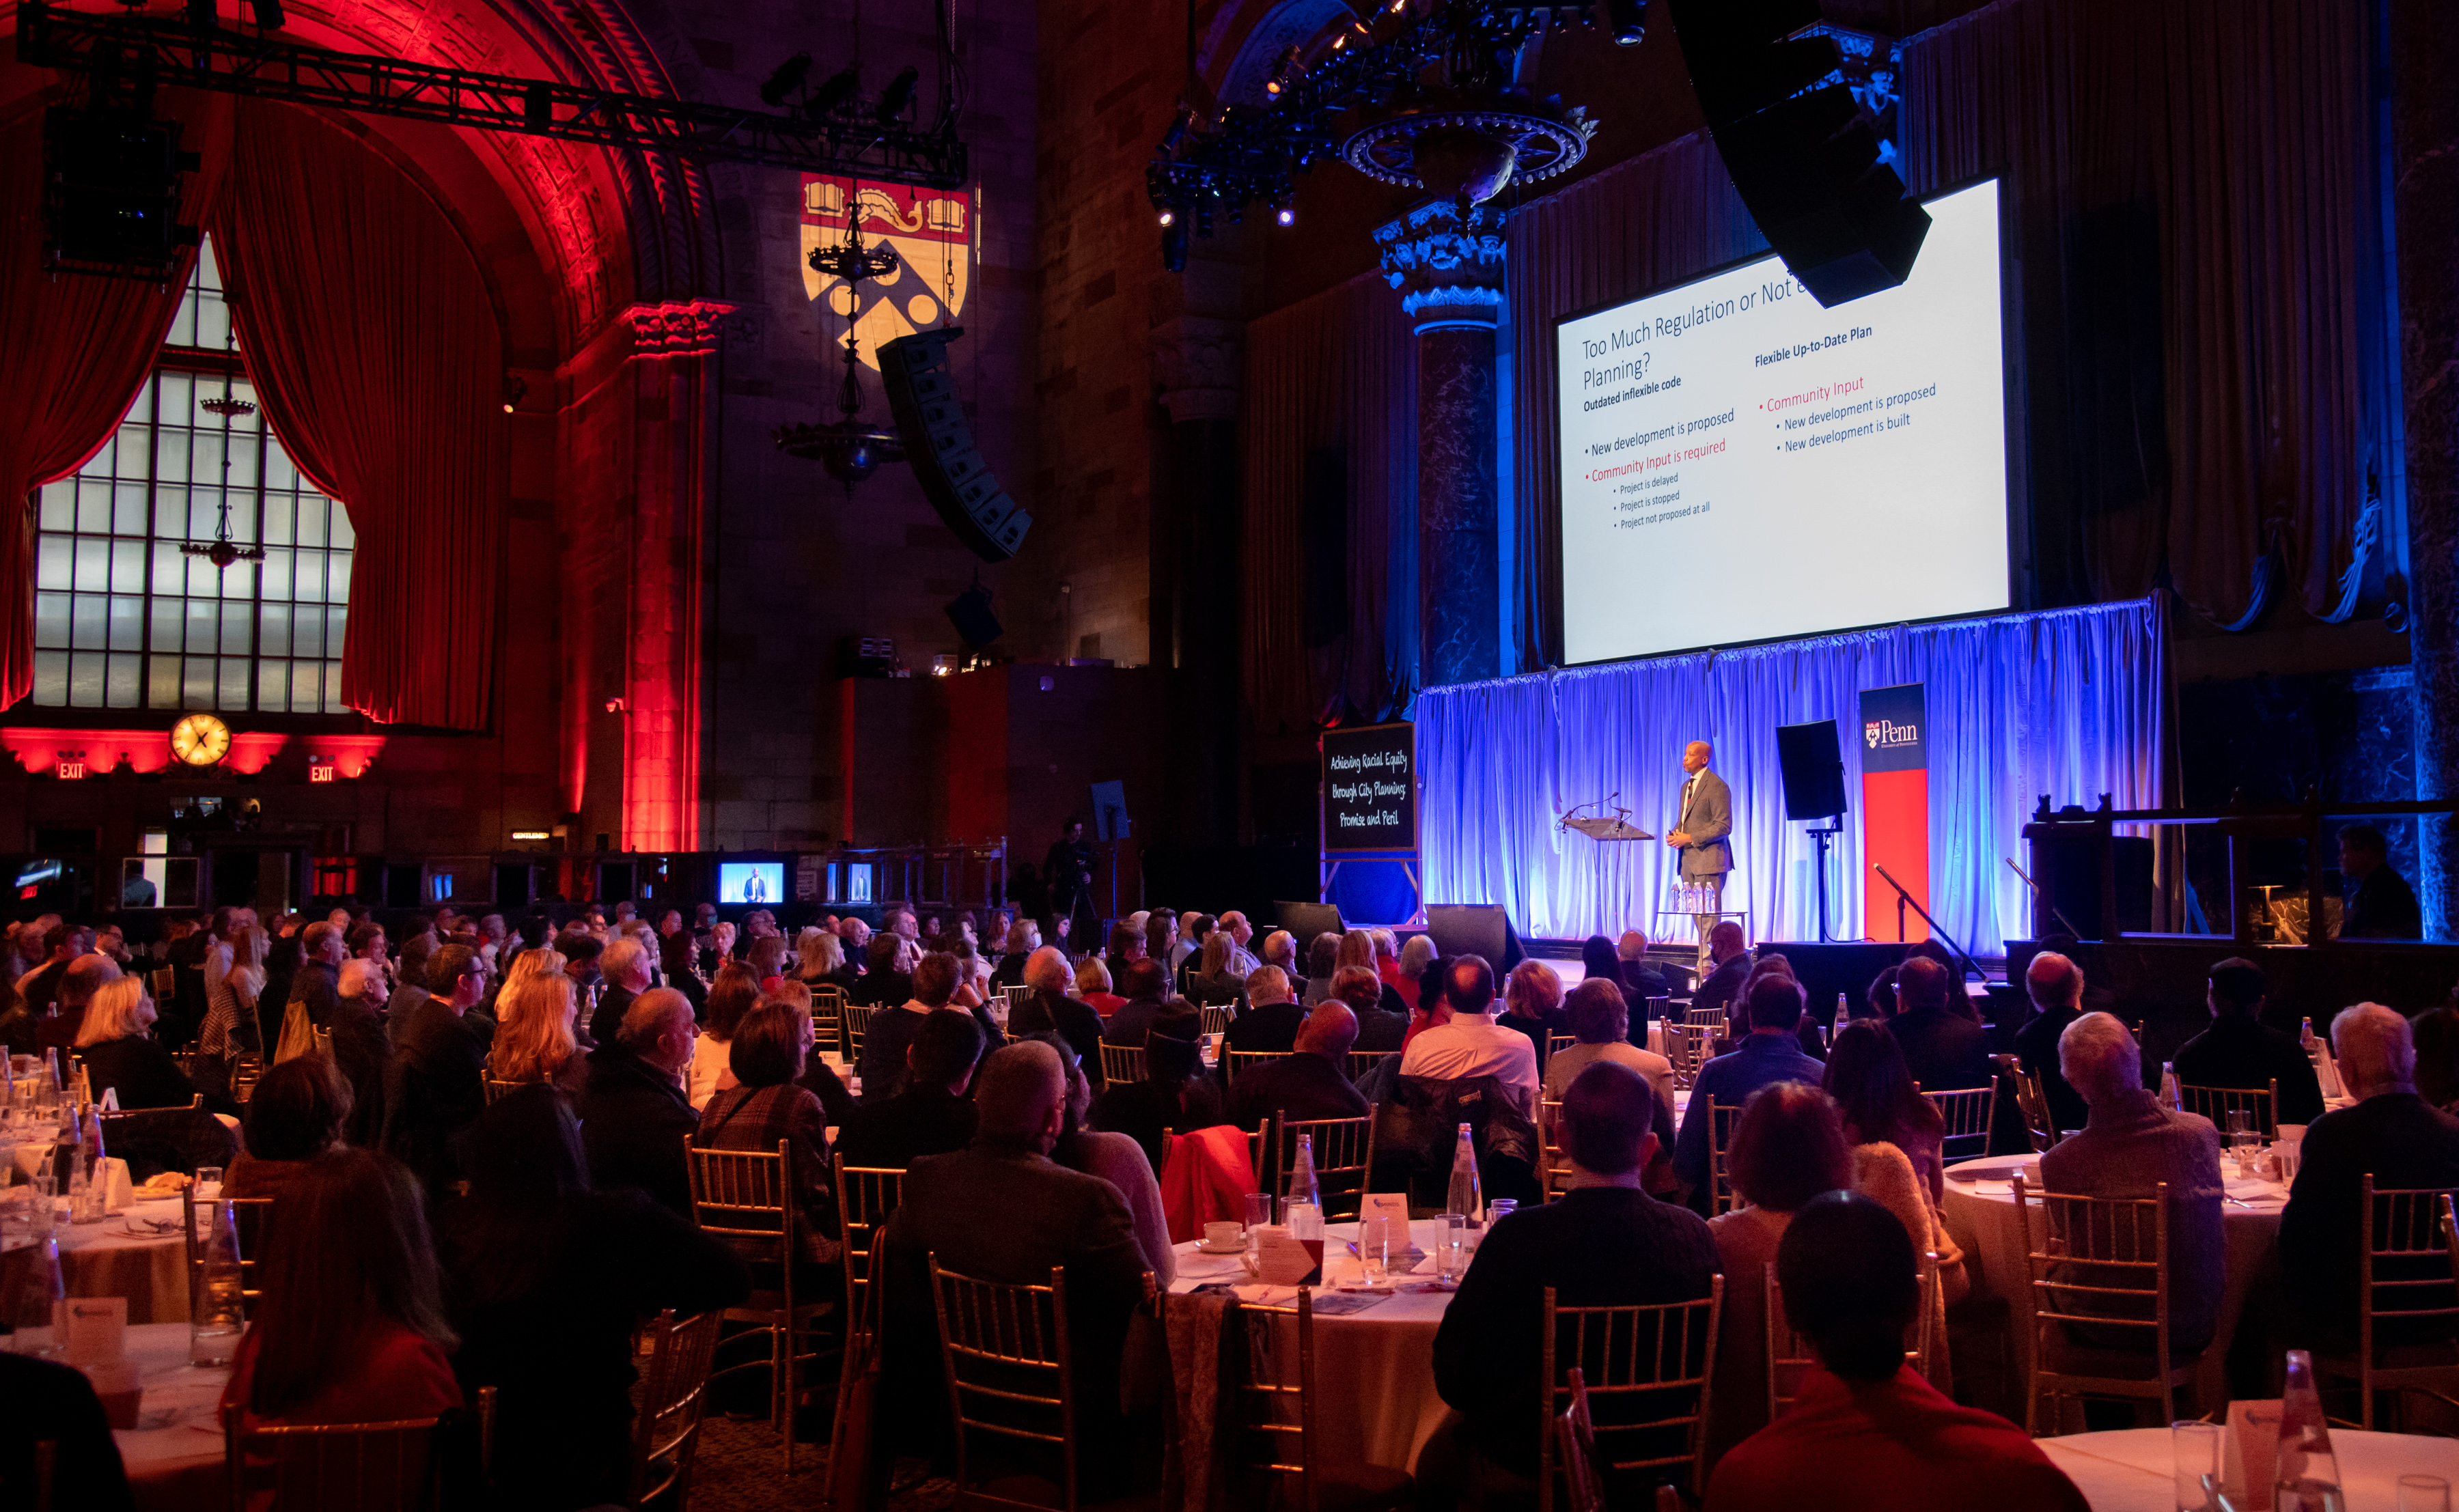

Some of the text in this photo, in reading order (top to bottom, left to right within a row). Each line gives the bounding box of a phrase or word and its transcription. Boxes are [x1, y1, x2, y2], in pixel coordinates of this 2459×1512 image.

[1583, 340, 1607, 359] Too
[1611, 322, 1650, 351] Much
[1656, 300, 1734, 337] Regulation
[1740, 292, 1757, 311] or
[1762, 278, 1792, 305] Not
[1755, 326, 1872, 367] Flexible Up-to-Date Plan
[1584, 352, 1651, 390] Planning?
[1583, 376, 1682, 412] Outdated inflexible code
[1767, 376, 1864, 412] Community Input
[1784, 382, 1936, 431] New development is proposed
[1592, 408, 1735, 457] New development is proposed
[1785, 413, 1911, 453] New development is built
[1592, 438, 1726, 482] Community Input is required
[1620, 472, 1679, 495] Project is delayed
[1620, 490, 1680, 512] Project is stopped
[1621, 501, 1710, 530] Project not proposed at all
[1880, 720, 1918, 743] Penn
[59, 763, 84, 779] EXIT
[311, 766, 334, 781] EXIT
[1331, 749, 1408, 774] Achieving Racial Equity
[1332, 781, 1406, 805] through City Planning:
[1339, 809, 1399, 827] Promise and Peril
